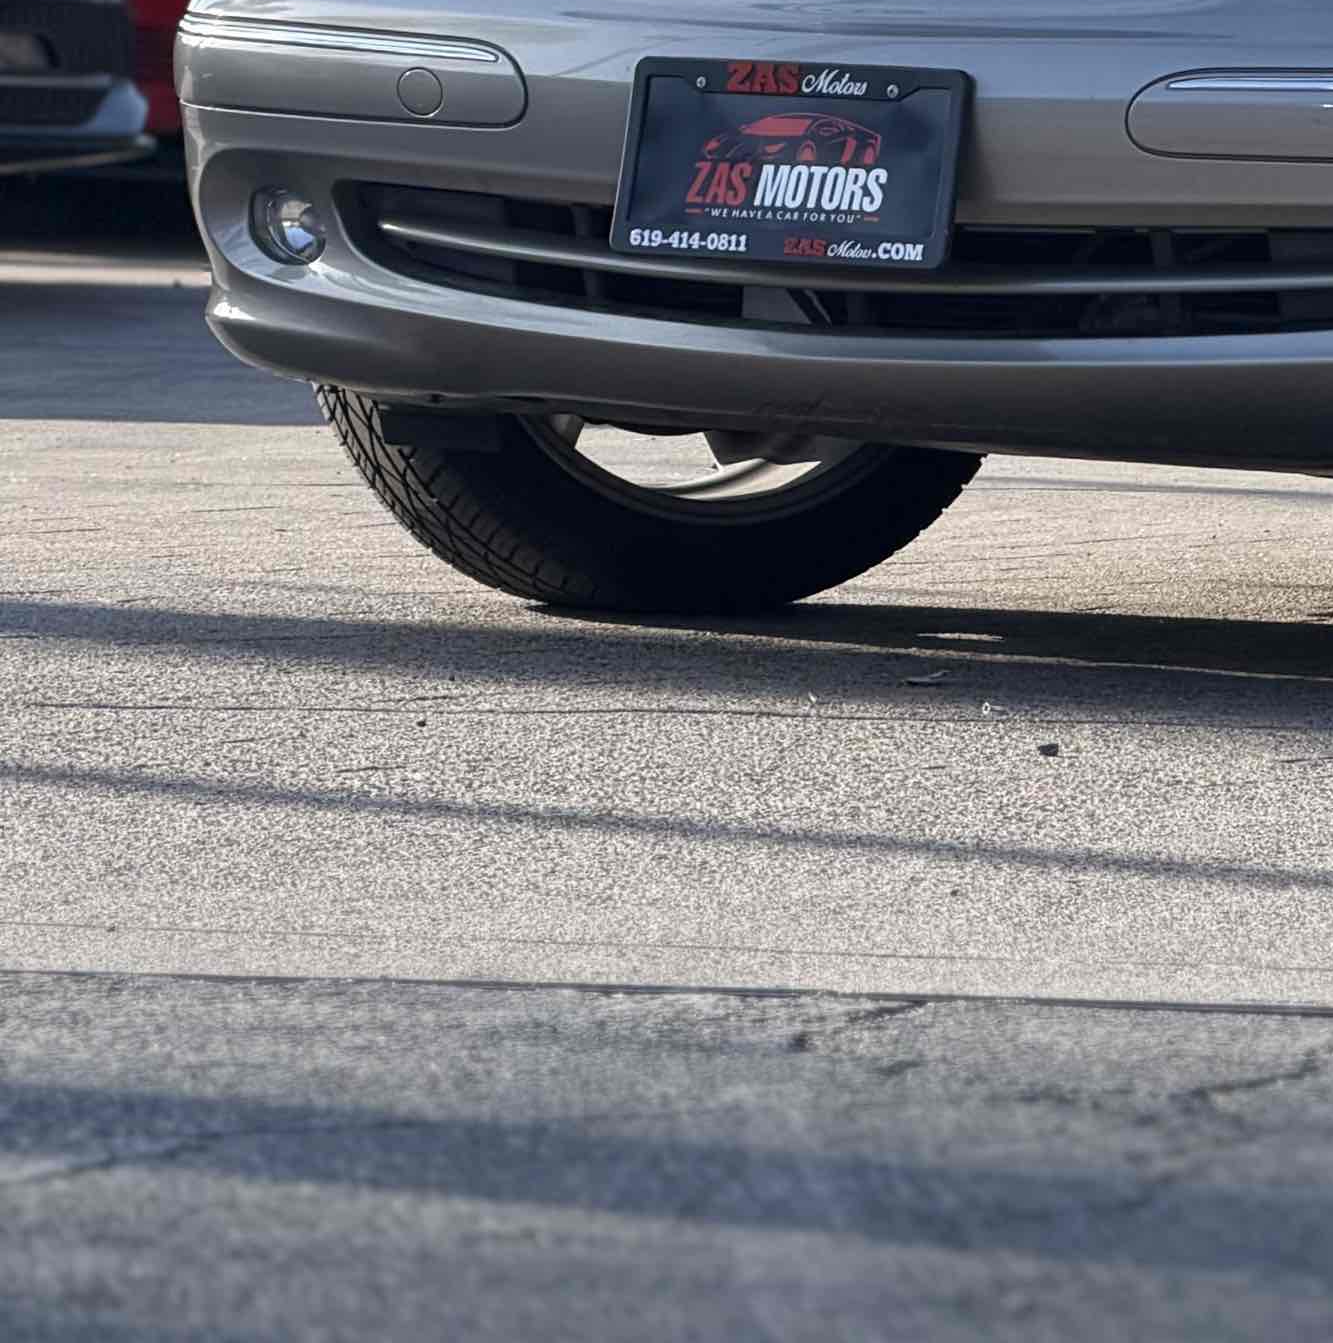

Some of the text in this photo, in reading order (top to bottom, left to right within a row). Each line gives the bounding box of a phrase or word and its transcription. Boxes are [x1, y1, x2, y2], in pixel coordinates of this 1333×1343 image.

[727, 61, 868, 96] ZAS Motors
[686, 161, 888, 212] ZAS MOTORS
[732, 210, 762, 218] HAVE
[765, 210, 773, 220] A
[803, 212, 827, 223] FOR
[629, 229, 748, 252] 619-414-0811
